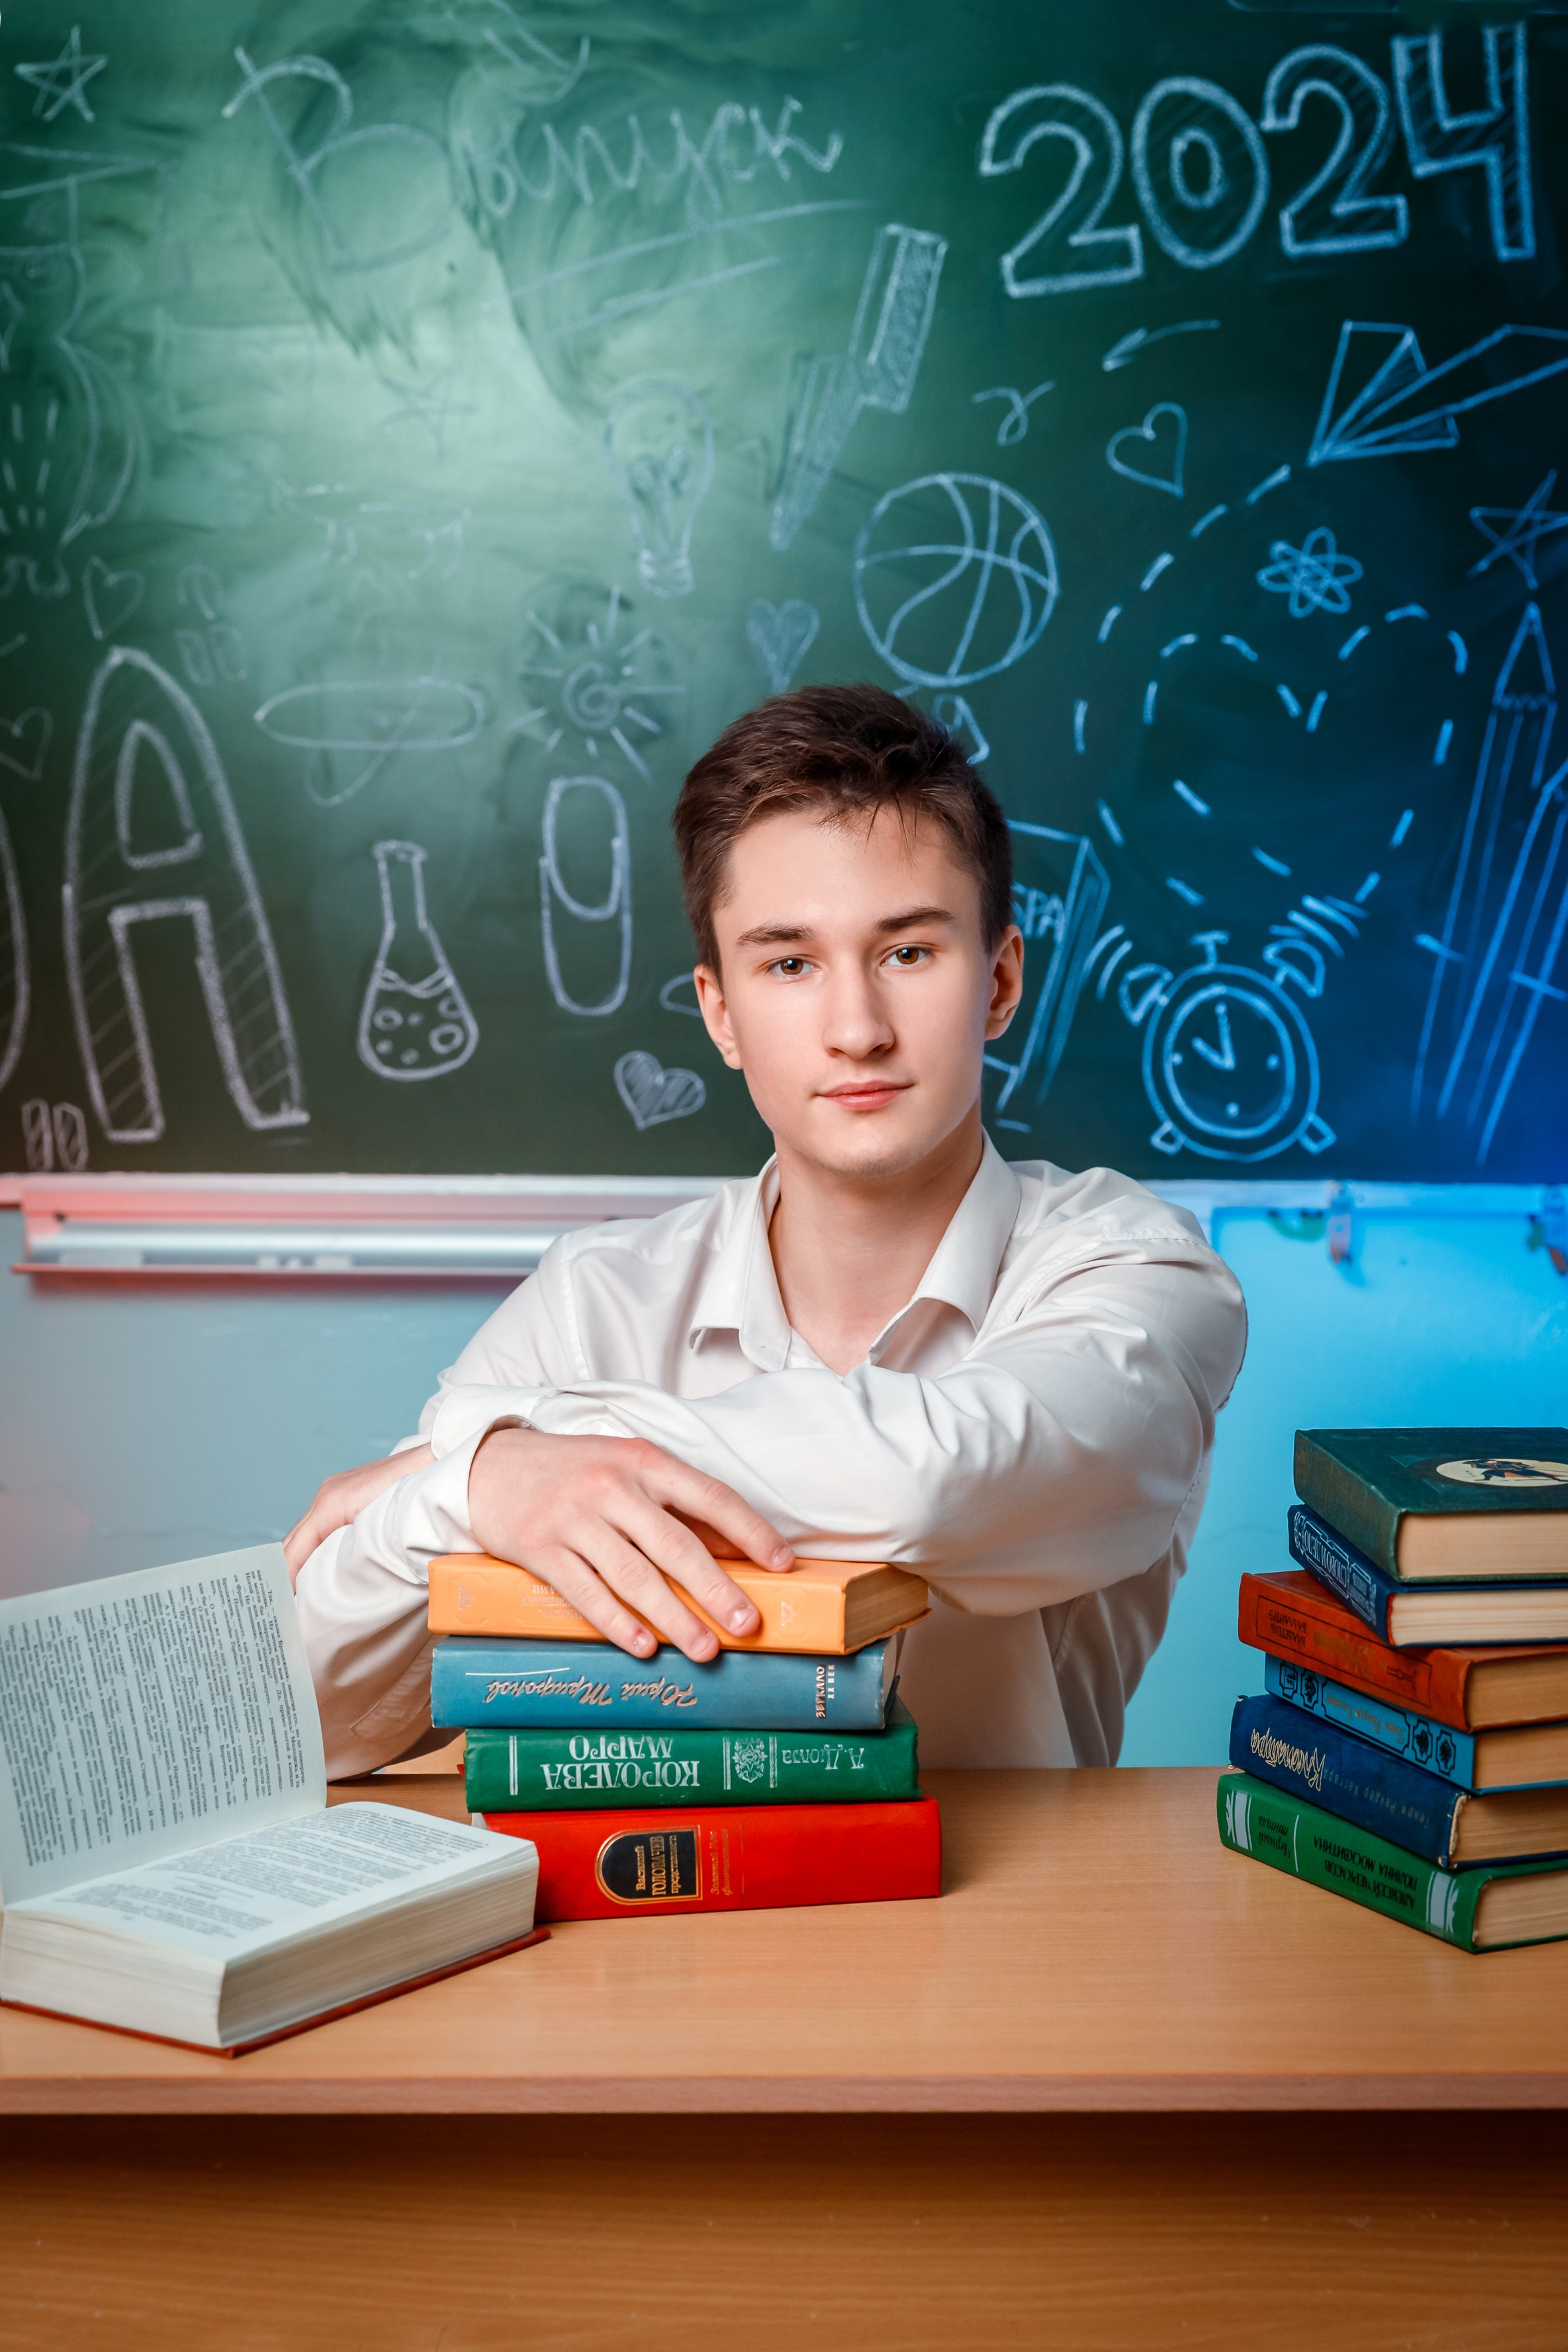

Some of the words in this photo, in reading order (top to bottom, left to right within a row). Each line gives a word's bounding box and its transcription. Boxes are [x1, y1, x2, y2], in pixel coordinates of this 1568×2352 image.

[980, 20, 1536, 299] 2024
[1304, 1529, 1321, 1563] ДЕЛО
[1321, 1547, 1326, 1569] И
[1327, 1551, 1347, 1588] СЛОВО
[1269, 1609, 1307, 1633] БАЛЛАНТРЭ
[1271, 1623, 1306, 1647] ВЛАДЕТЕЛЬ
[483, 1674, 612, 1707] Трифонов
[621, 1676, 697, 1707] Юрий
[815, 1666, 826, 1718] ЗЕРКАЛО
[568, 1735, 674, 1761] МАРГО
[1251, 1727, 1326, 1792] Клеопатра
[540, 1761, 700, 1790] КОРОЛЕВА
[1258, 1816, 1289, 1837] тополь
[634, 1845, 646, 1891] Василий
[650, 1836, 666, 1896] ГОЛОВАЧЕВ
[1314, 1836, 1375, 1872] МОСКВИТИНА
[1324, 1859, 1372, 1890] ЧЕРКАСОВ
[1379, 1862, 1418, 1891] ПОЛИНА
[1373, 1880, 1416, 1909] АЛЕКСЕЙ
